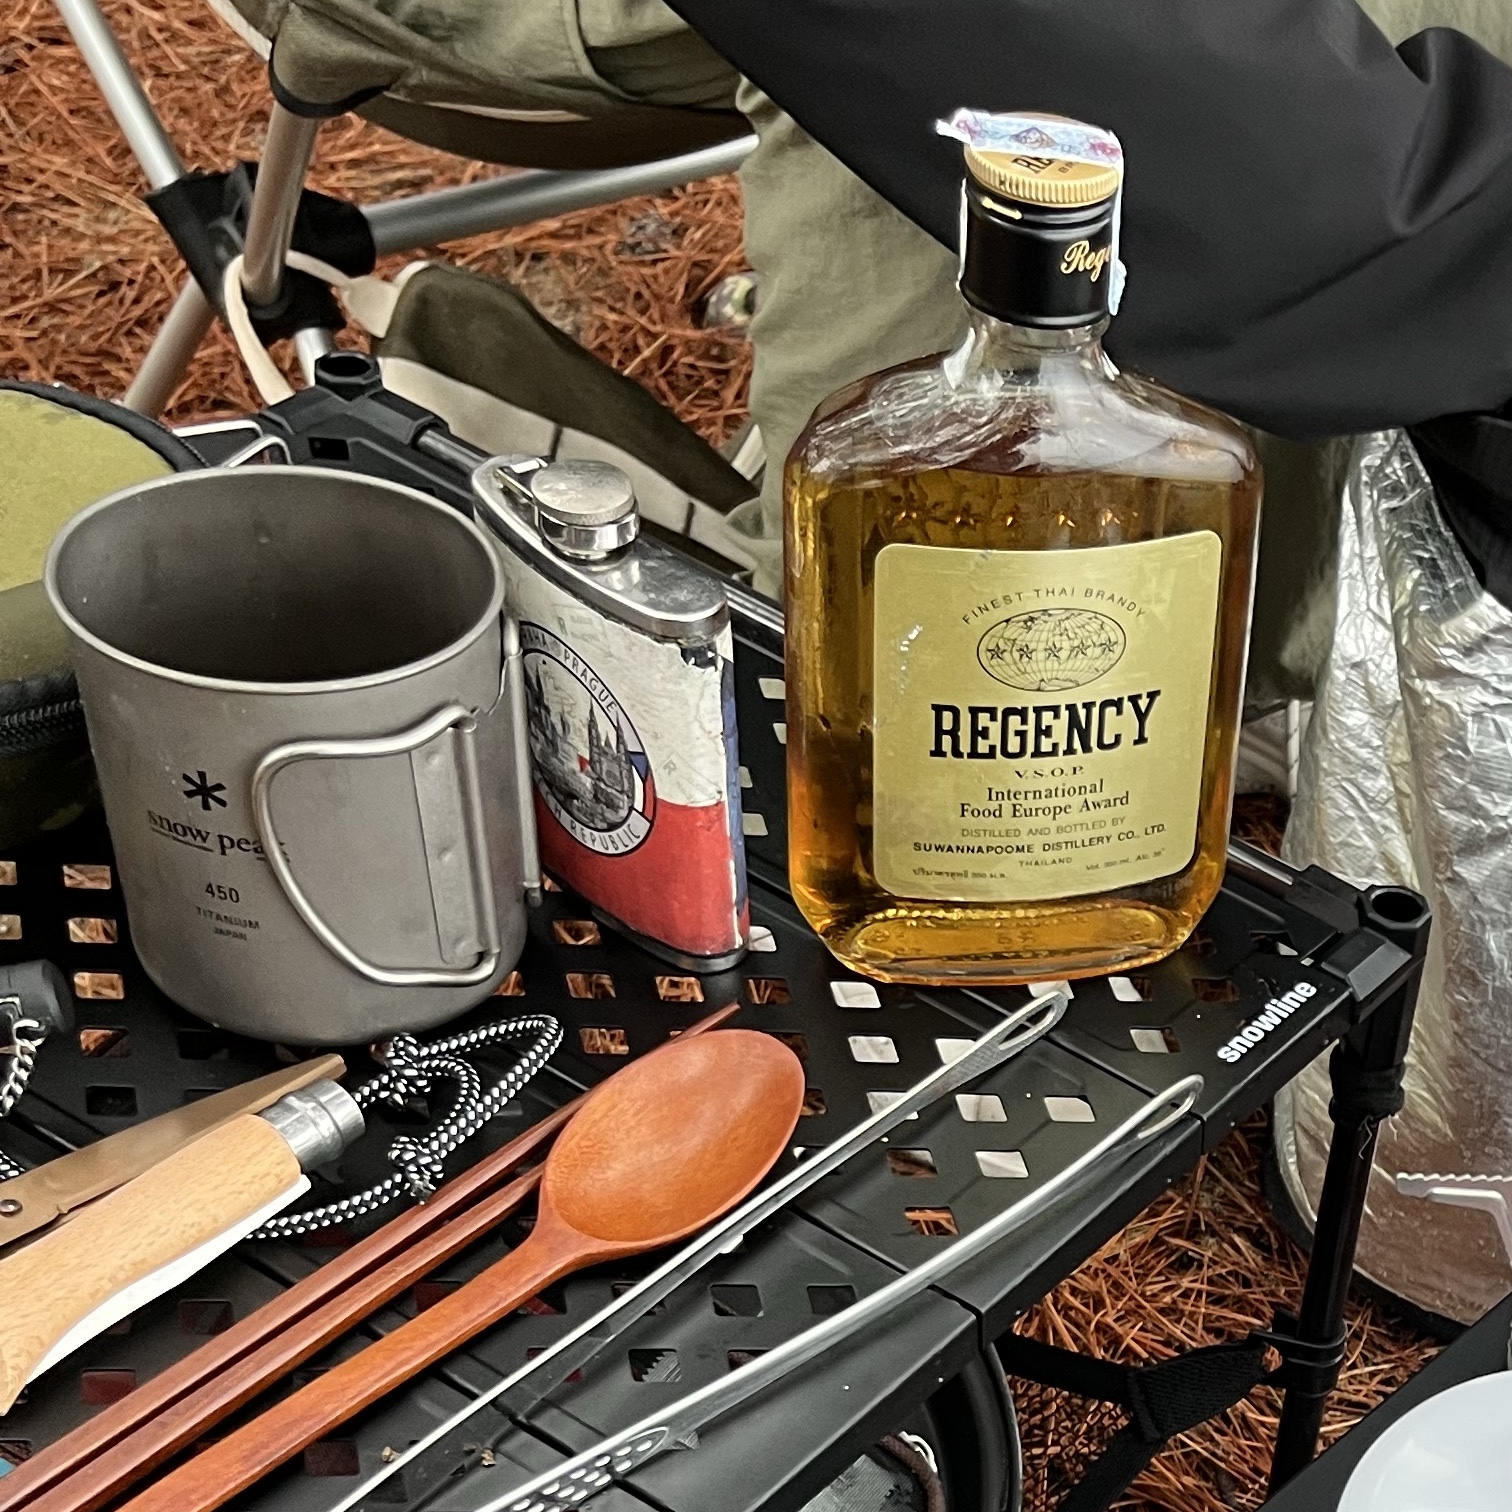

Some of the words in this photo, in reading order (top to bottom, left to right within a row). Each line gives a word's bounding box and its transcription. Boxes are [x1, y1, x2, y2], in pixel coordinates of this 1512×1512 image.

[961, 590, 1024, 625] FINEST
[1033, 587, 1076, 598] THAI
[1084, 587, 1147, 619] BRANDY
[563, 648, 618, 713] PRAGUE
[929, 689, 1162, 760] REGENCY
[987, 778, 1104, 801] International
[960, 802, 1003, 818] Food
[1011, 803, 1072, 821] Europe
[1079, 791, 1130, 813] Award
[147, 810, 211, 844] snow
[570, 820, 641, 851] REPUBLIC
[961, 828, 1022, 838] DISTILLED
[1027, 827, 1051, 836] AND
[1056, 819, 1107, 834] BOTTLED
[1111, 816, 1127, 827] BY
[913, 841, 1035, 855] SUWANNAPOOME
[1042, 835, 1113, 852] DISTILLERY
[1018, 857, 1073, 868] THAILAND
[205, 882, 240, 904] 450
[196, 905, 260, 930] TITANIUM
[213, 927, 247, 941] JAPAN
[1217, 982, 1317, 1063] snowline
